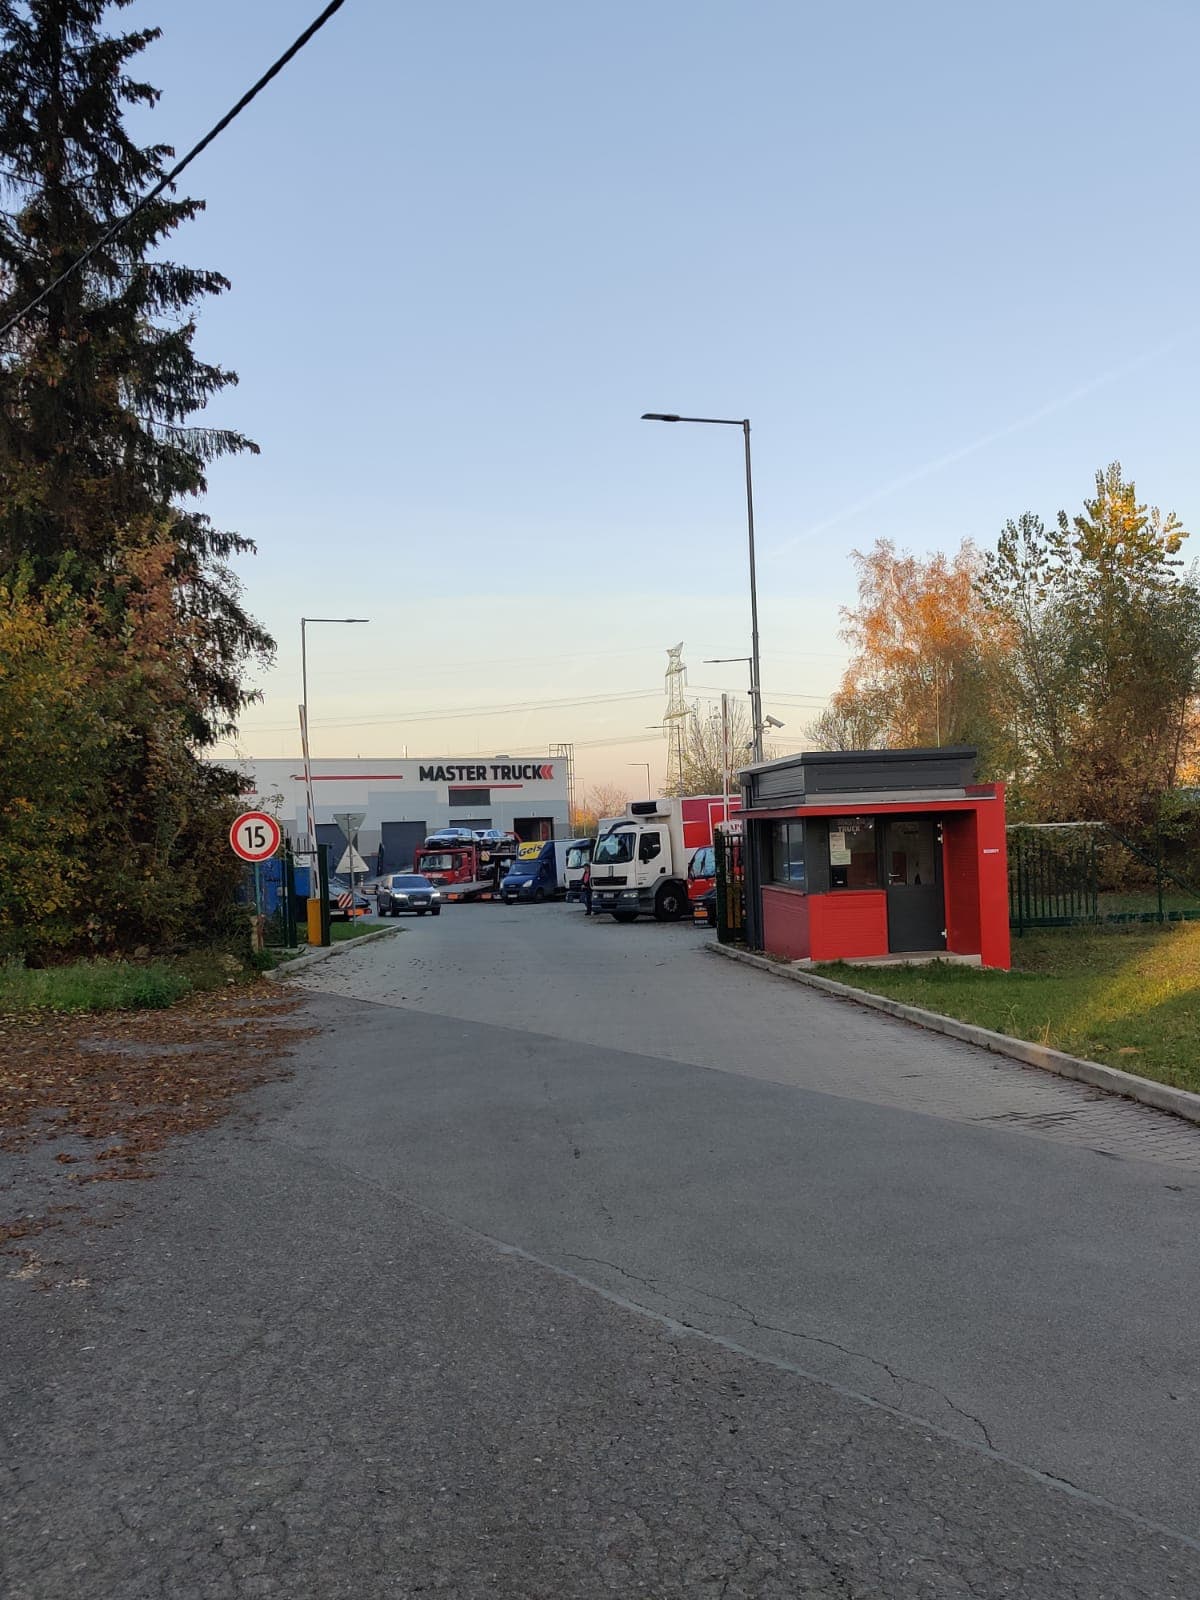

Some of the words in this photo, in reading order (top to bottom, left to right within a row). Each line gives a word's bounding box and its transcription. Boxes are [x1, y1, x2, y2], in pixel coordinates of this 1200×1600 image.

[419, 765, 487, 782] MASTER
[490, 764, 542, 781] TRUCK
[244, 826, 266, 849] 15
[518, 843, 545, 857] Geis
